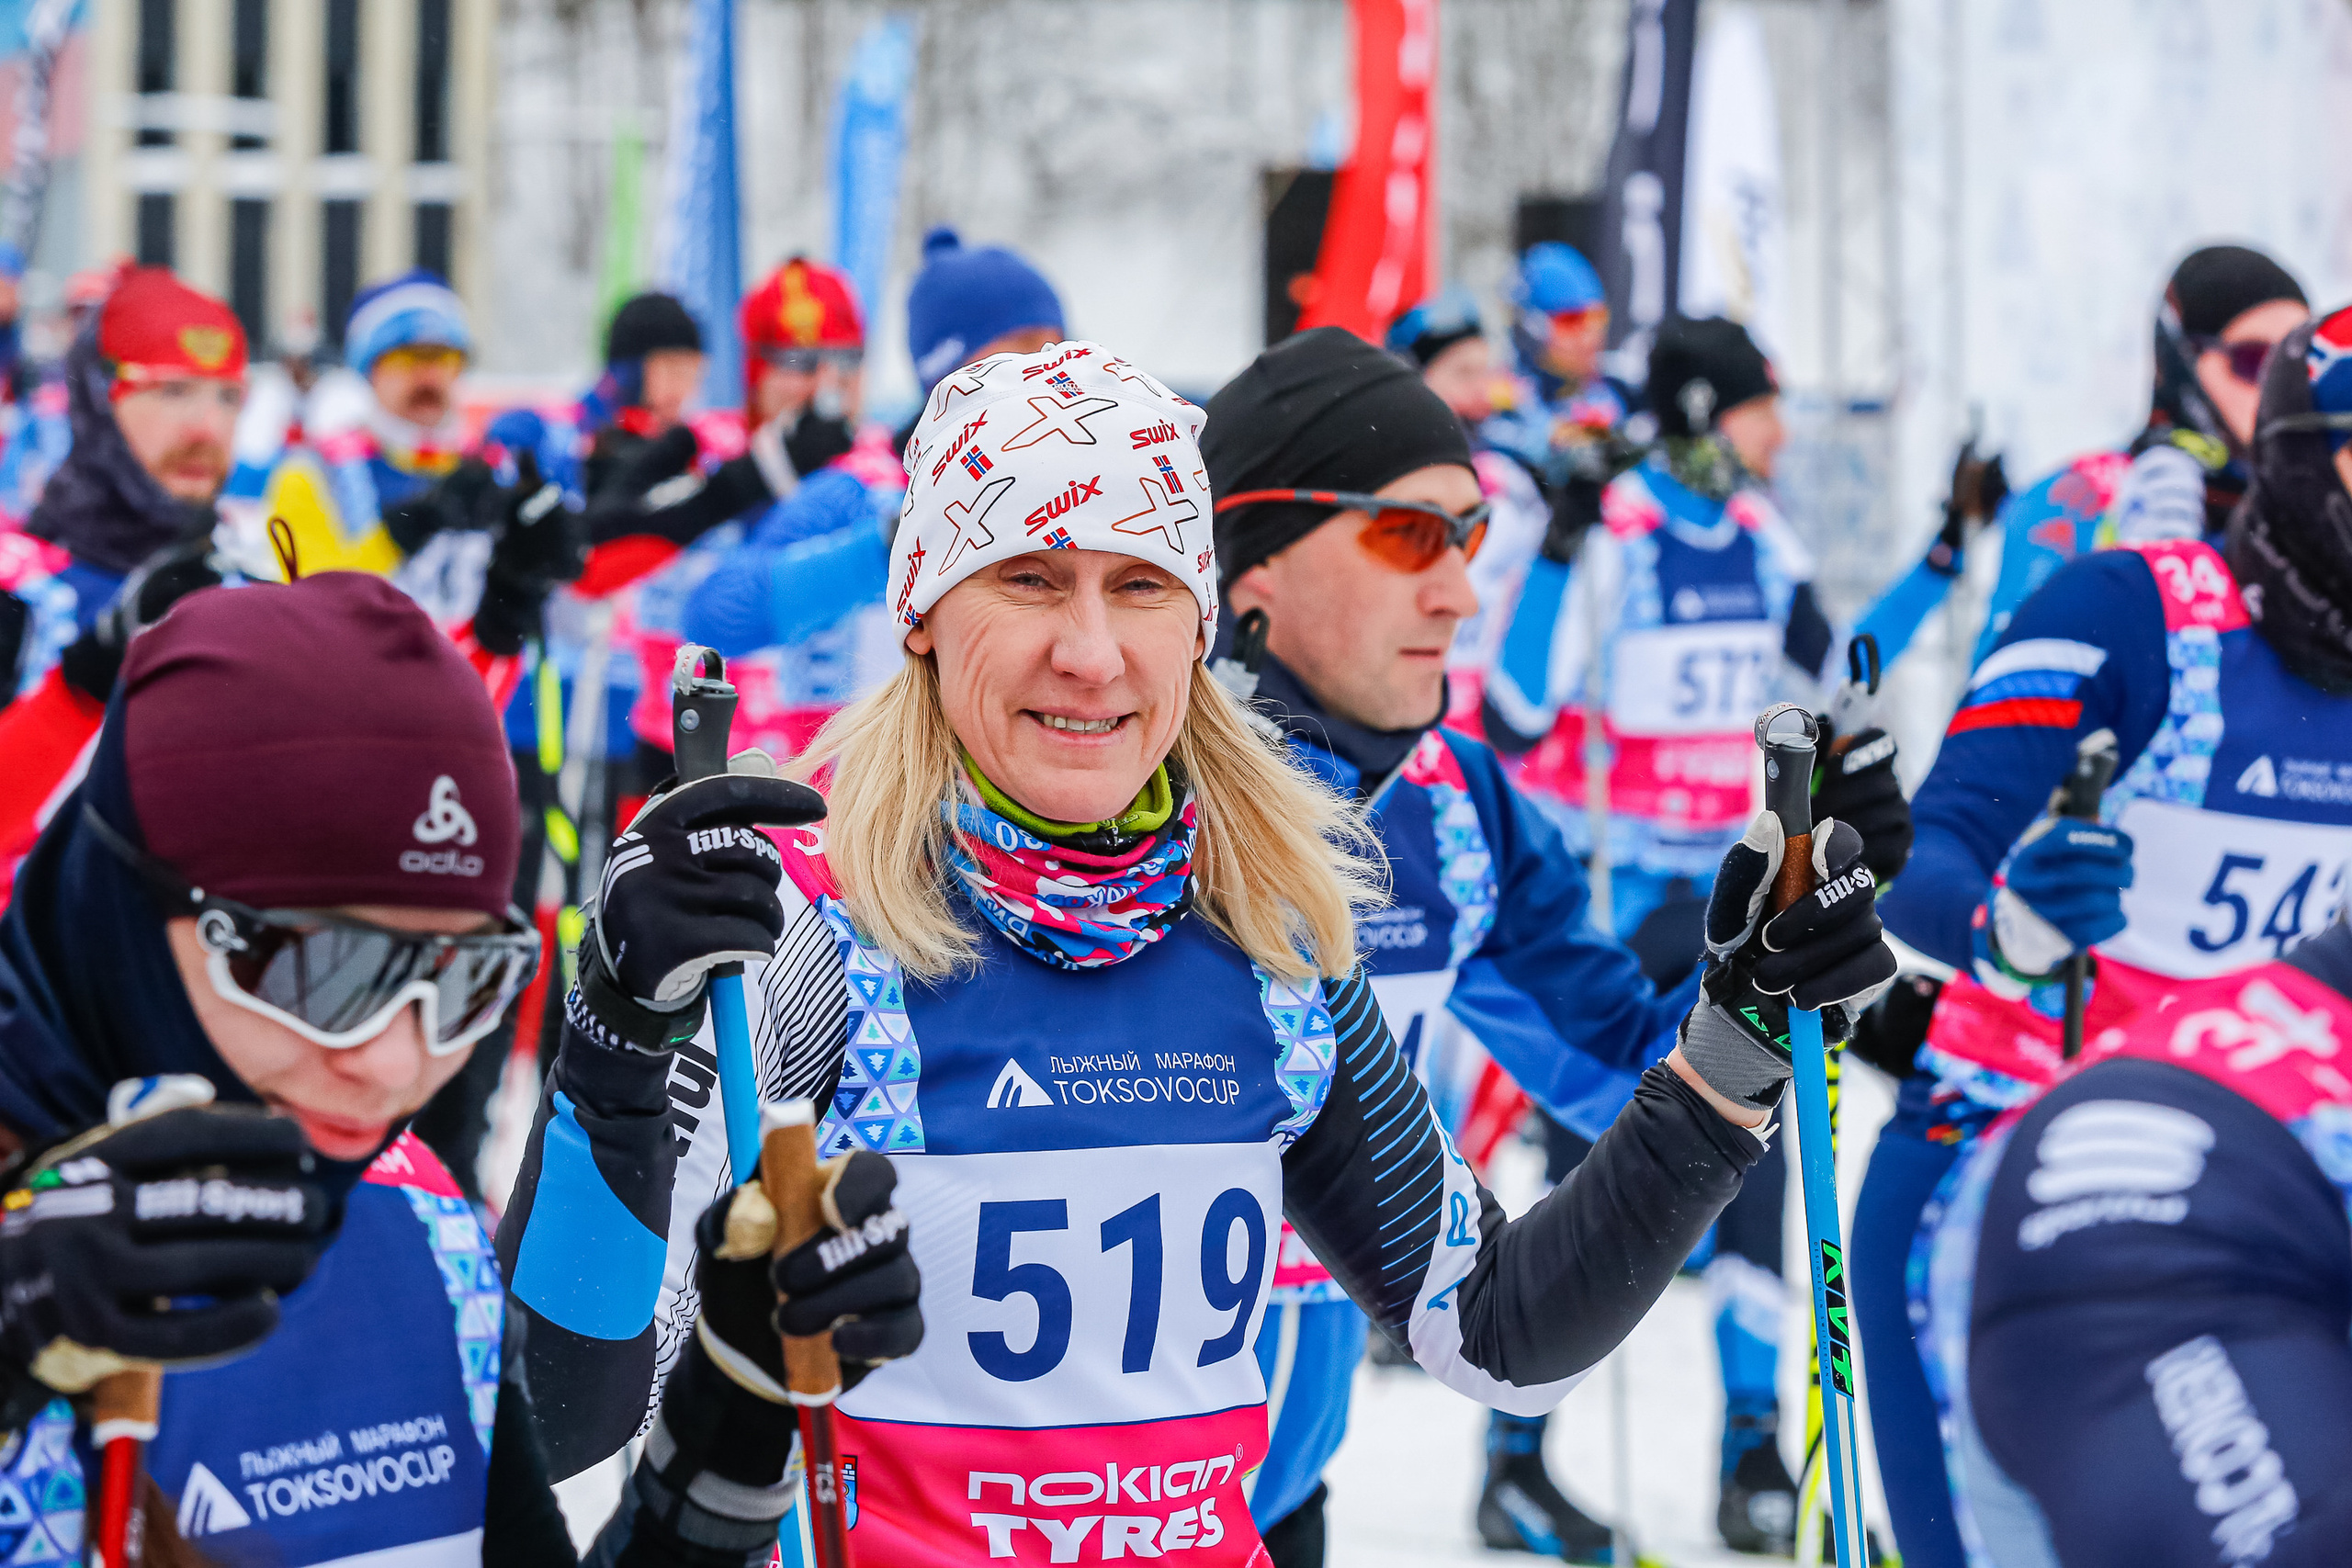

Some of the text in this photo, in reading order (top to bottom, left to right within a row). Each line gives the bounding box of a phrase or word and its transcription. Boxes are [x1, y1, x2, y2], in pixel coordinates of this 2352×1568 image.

[2188, 852, 2345, 957] 54
[1050, 1050, 1236, 1074] ЛЫЖНЫЙ МАРАФОН
[1053, 1076, 1240, 1105] TOKSOVOCUP
[967, 1187, 1268, 1382] 519
[244, 1444, 456, 1520] TOKSOVOCUP
[969, 1496, 1226, 1563] TYRES
